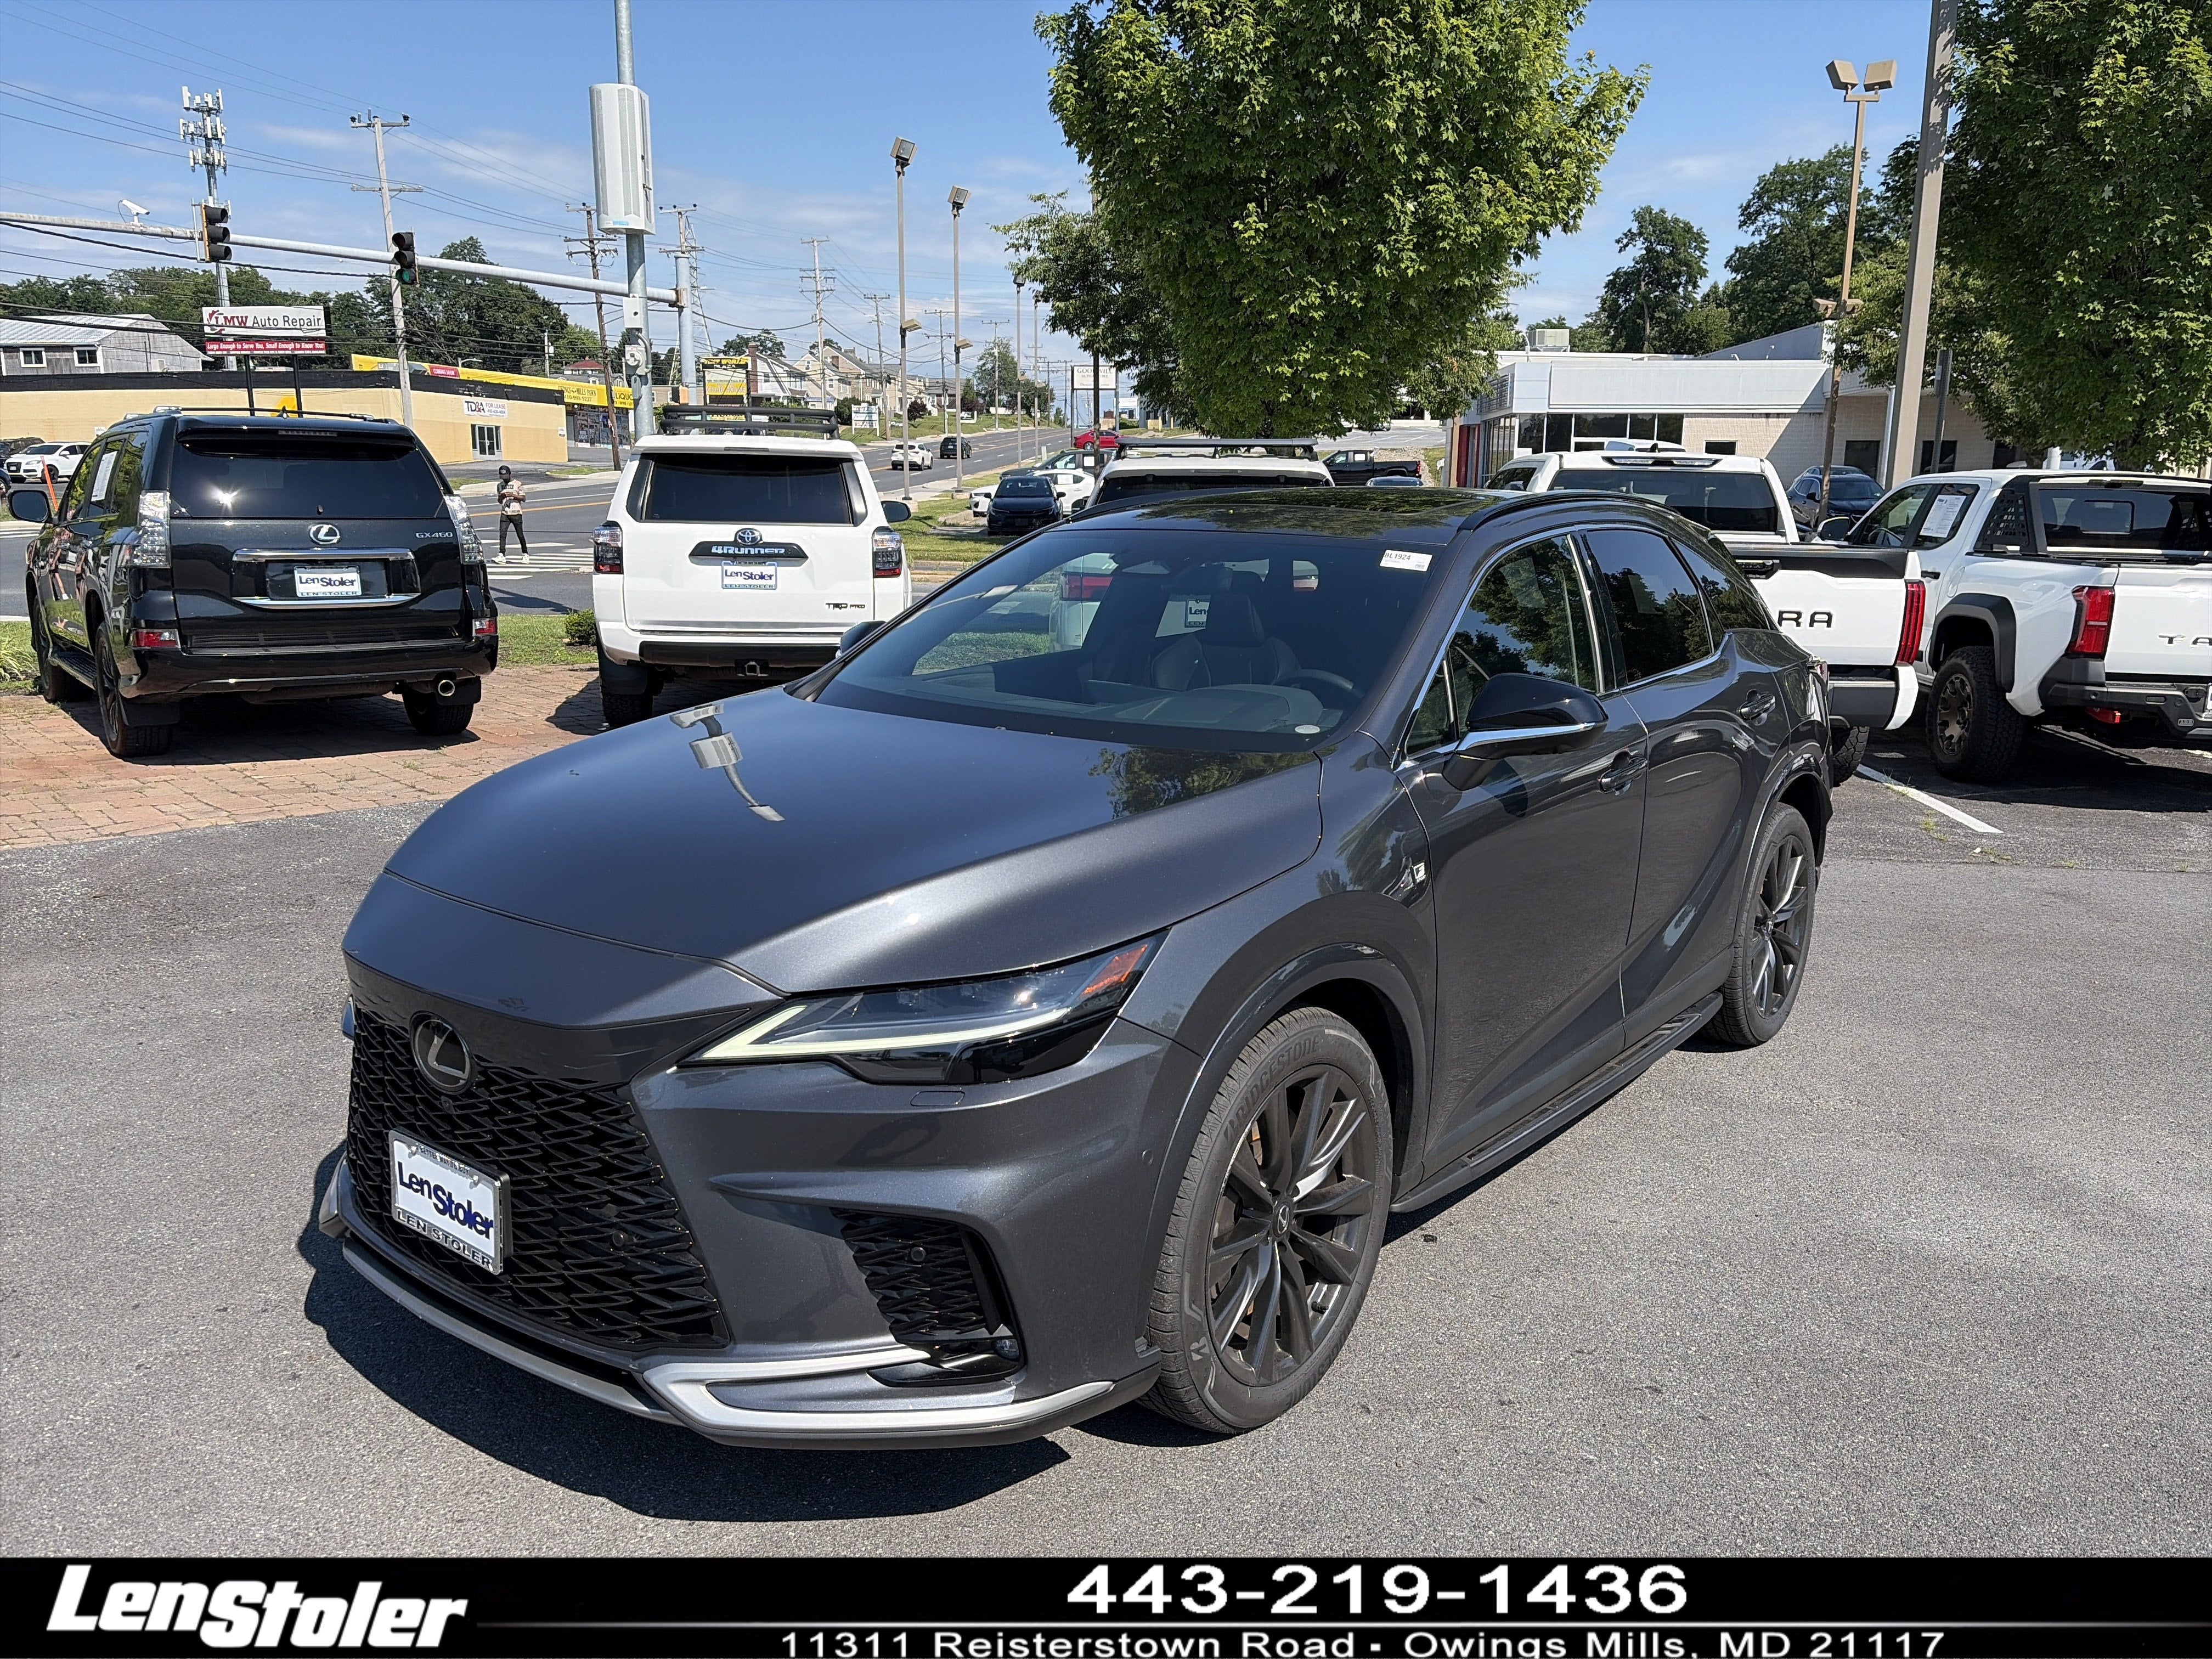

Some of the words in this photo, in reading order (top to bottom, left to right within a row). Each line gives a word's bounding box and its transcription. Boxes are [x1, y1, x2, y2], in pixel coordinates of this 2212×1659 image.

[215, 315, 249, 327] LMW
[252, 315, 279, 327] Auto
[283, 315, 321, 329] Repair
[207, 342, 219, 351] Large
[220, 342, 236, 351] Enough
[397, 1209, 427, 1233] LEN
[432, 1228, 493, 1272] STOLER
